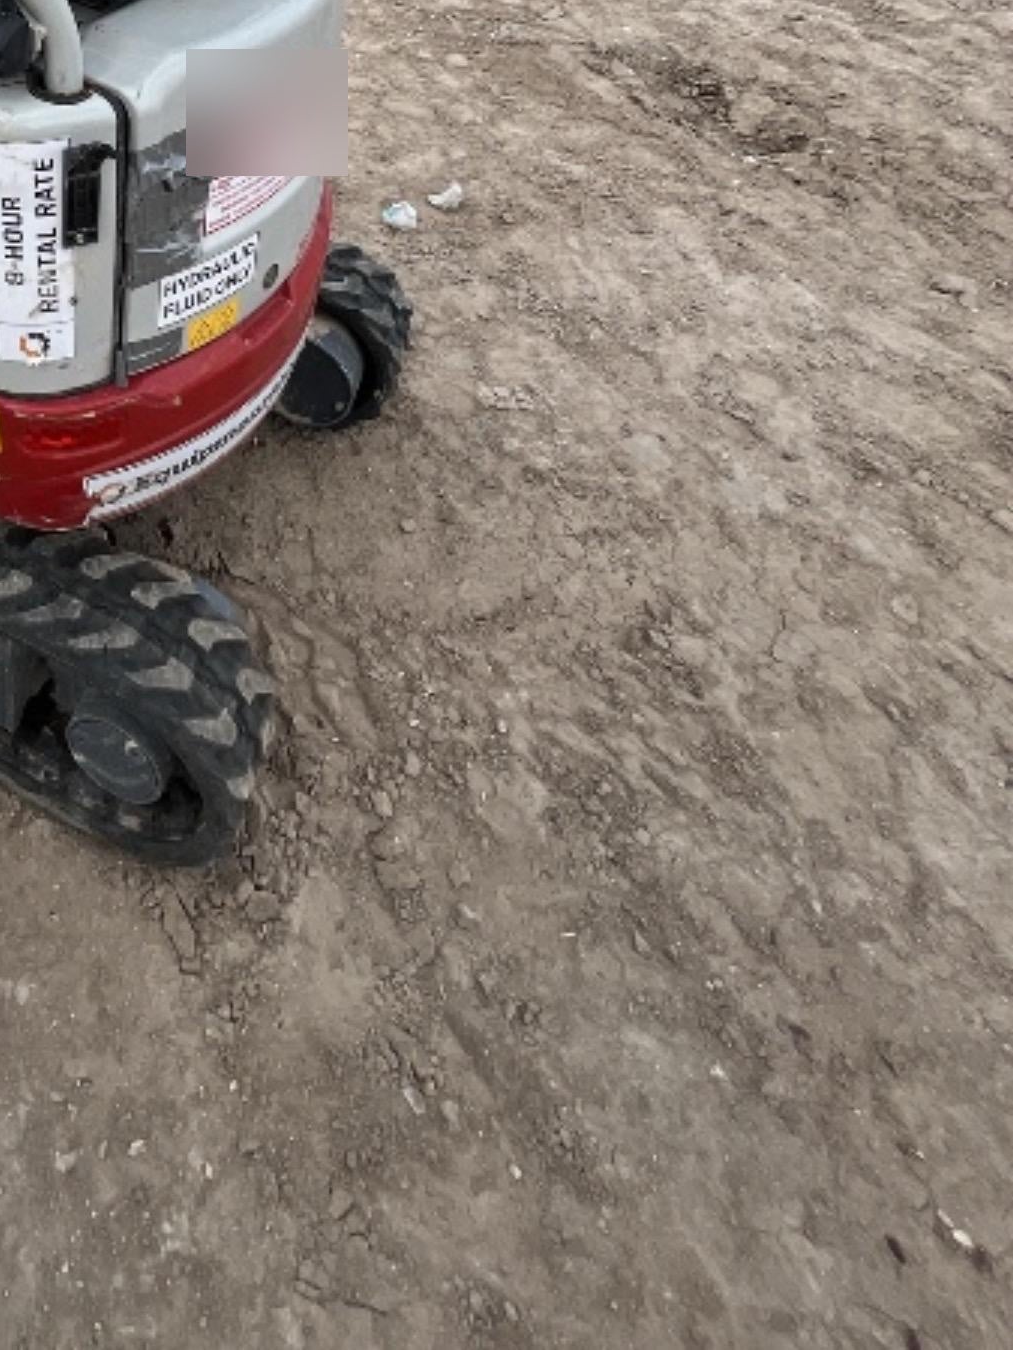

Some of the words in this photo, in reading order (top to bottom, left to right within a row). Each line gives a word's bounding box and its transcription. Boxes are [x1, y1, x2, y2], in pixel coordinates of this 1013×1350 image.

[34, 157, 58, 218] RATE
[37, 227, 60, 314] RENTAL
[163, 286, 213, 319] FLUID
